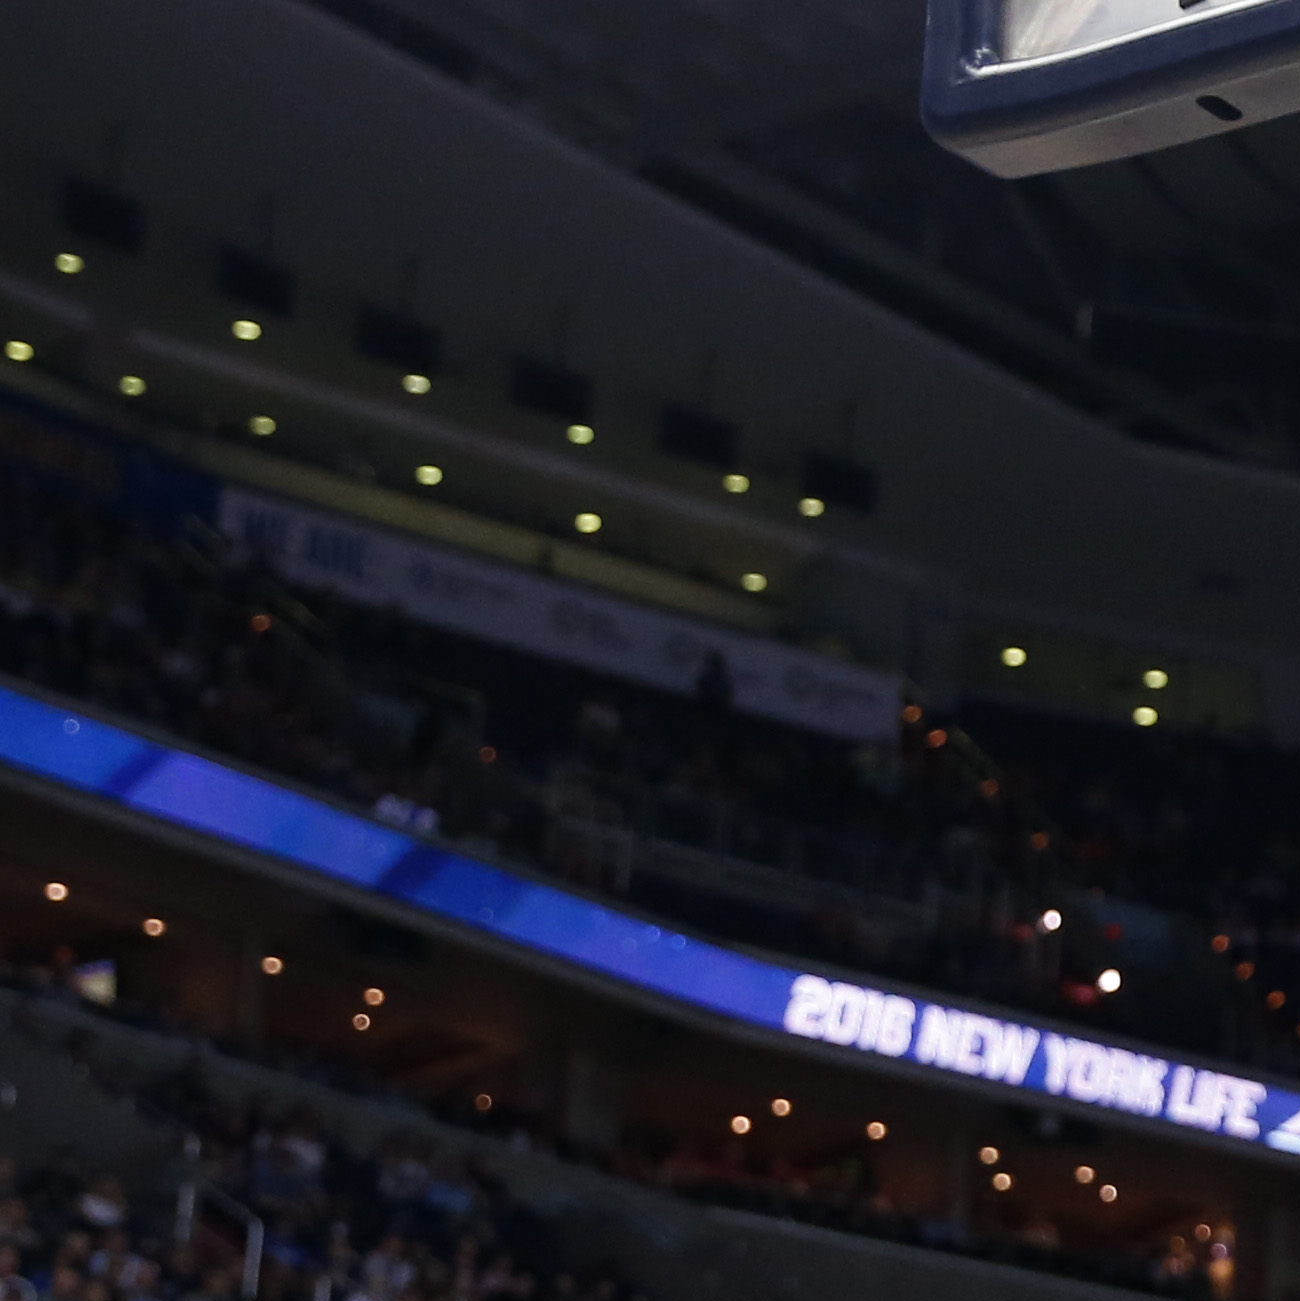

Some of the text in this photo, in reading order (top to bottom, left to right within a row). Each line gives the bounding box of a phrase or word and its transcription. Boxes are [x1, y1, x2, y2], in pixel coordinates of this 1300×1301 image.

[783, 973, 916, 1057] 2016
[915, 1003, 1041, 1086] NEW
[1043, 1031, 1170, 1118] YORK
[1166, 1063, 1267, 1141] LIFE
